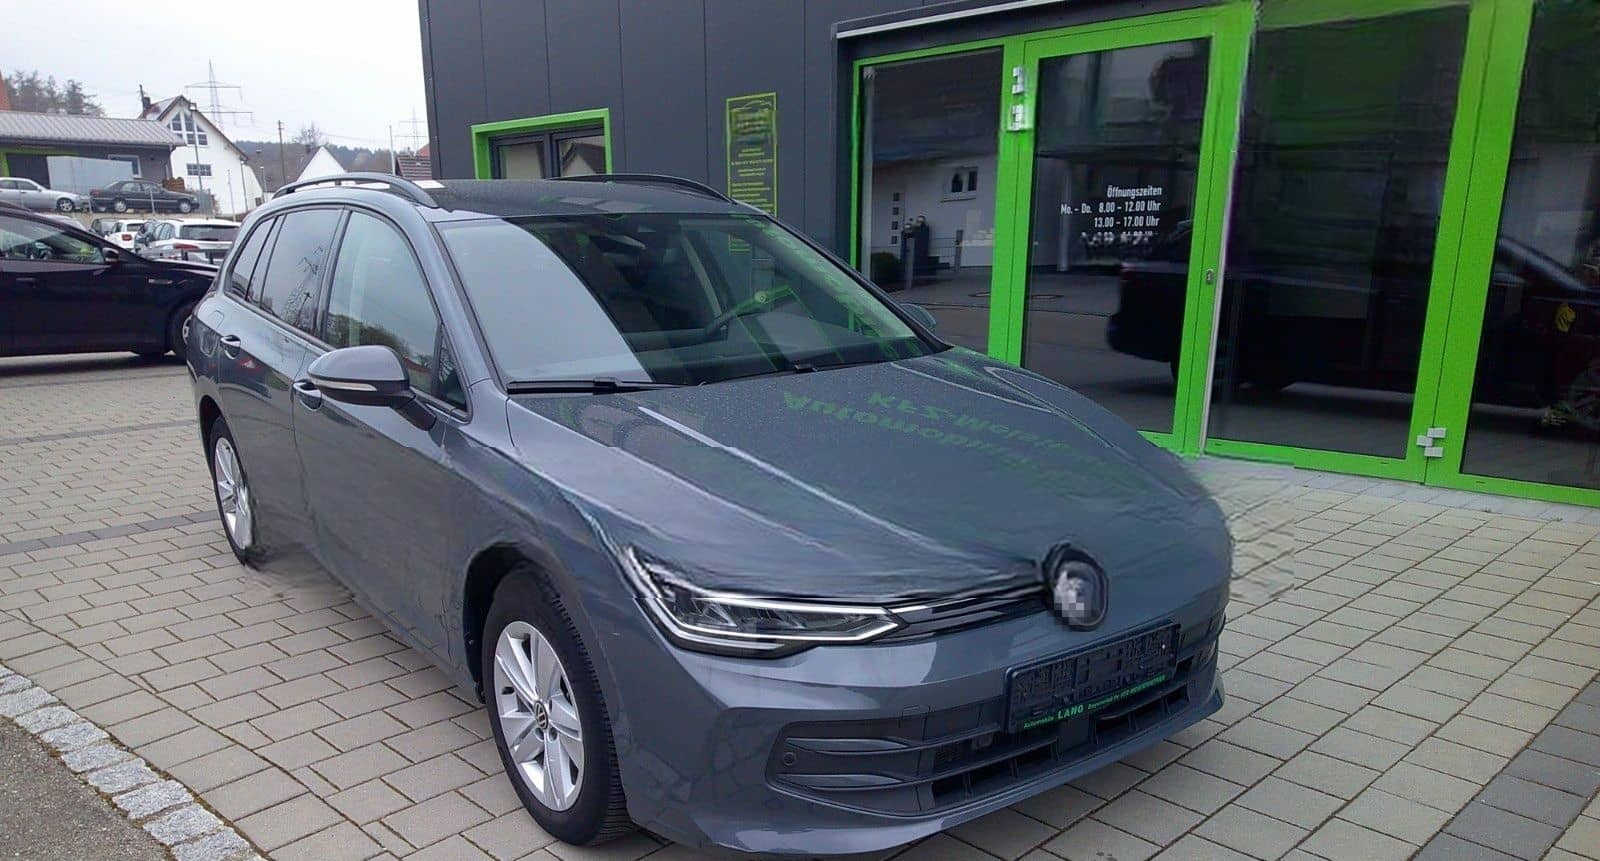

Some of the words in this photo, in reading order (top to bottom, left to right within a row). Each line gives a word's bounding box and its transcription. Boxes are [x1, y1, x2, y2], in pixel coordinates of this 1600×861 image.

[1107, 185, 1162, 199] Öffnungszeiten
[1060, 203, 1073, 214] Mo.
[1081, 203, 1092, 213] Do.
[1099, 202, 1115, 213] 8.00
[1125, 201, 1145, 212] 12.00
[1147, 200, 1161, 211] Uhr
[1094, 217, 1114, 227] 13.00
[1124, 216, 1144, 227] 17.00
[1146, 215, 1160, 226] Uhr
[1057, 704, 1085, 720] LANG
